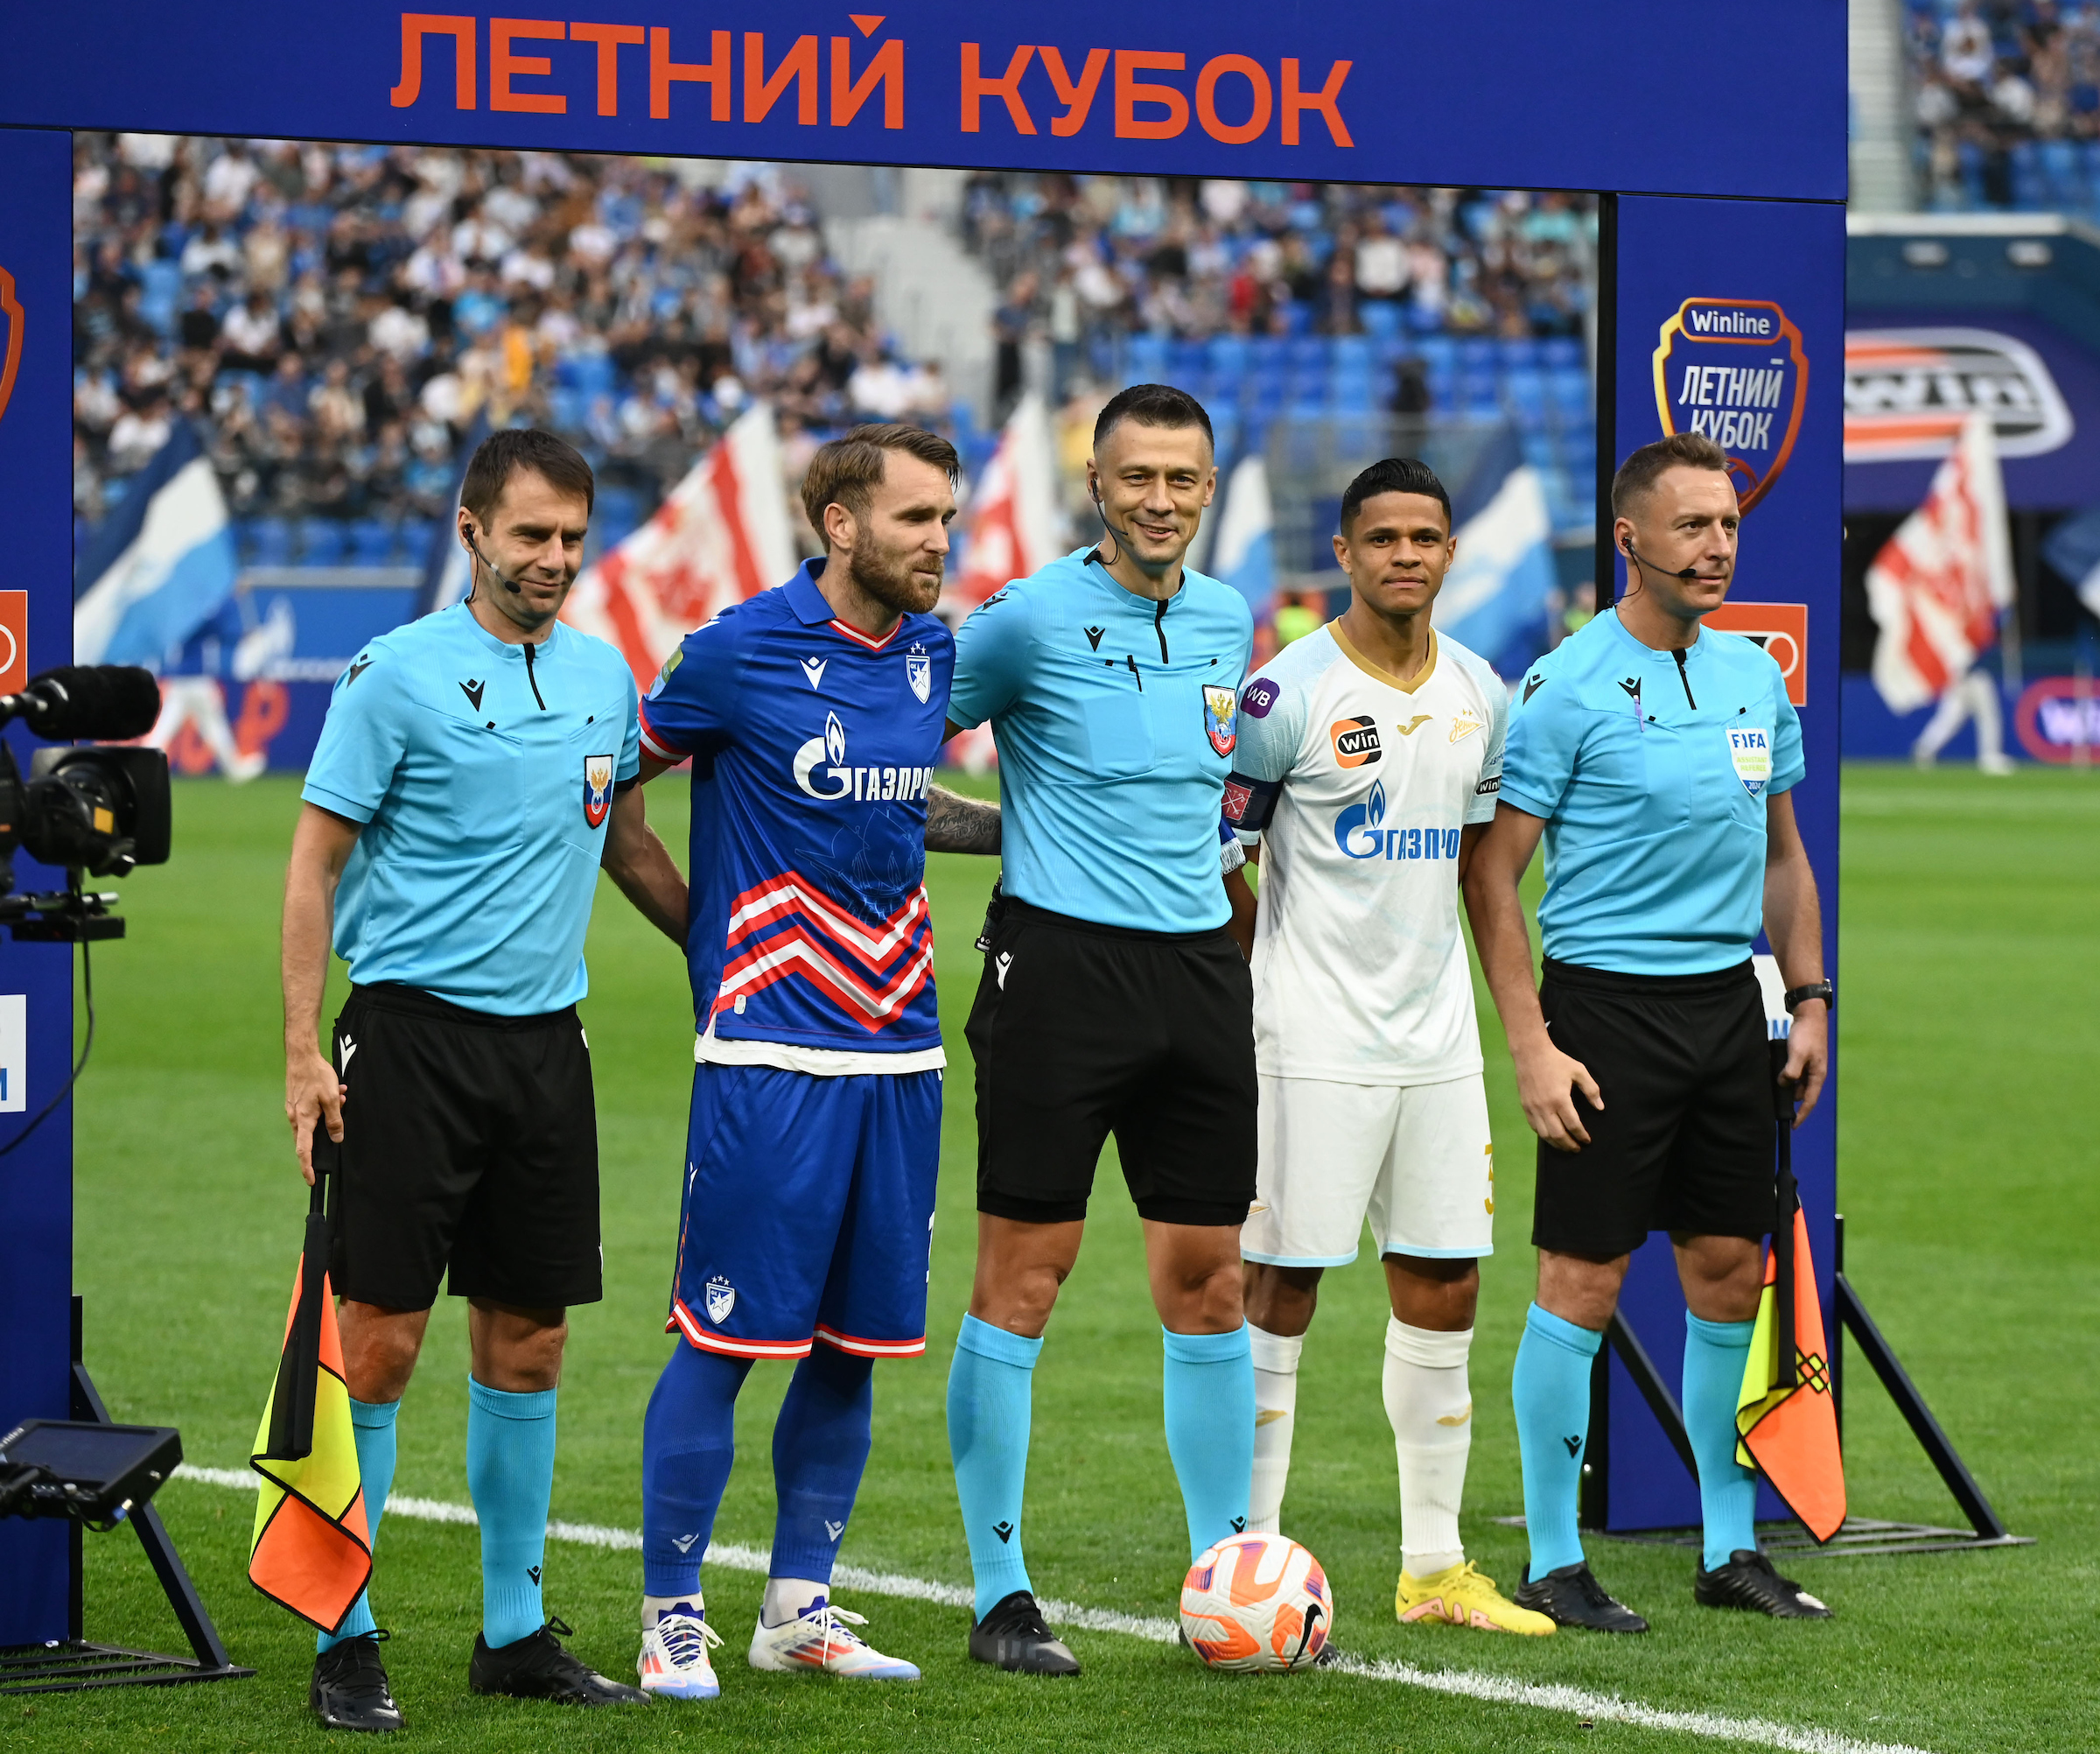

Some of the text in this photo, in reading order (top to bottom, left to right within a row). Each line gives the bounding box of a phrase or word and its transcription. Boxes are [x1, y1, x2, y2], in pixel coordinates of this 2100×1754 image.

[390, 12, 1354, 149] ЛЕТНИЙ КУБОК
[1691, 310, 1770, 335] Winline
[1678, 358, 1784, 409] ЛЕТНИЙ
[1690, 409, 1774, 451] КУБОК
[1247, 685, 1270, 706] WB
[1340, 733, 1379, 752] Win
[1732, 733, 1767, 748] FIFA
